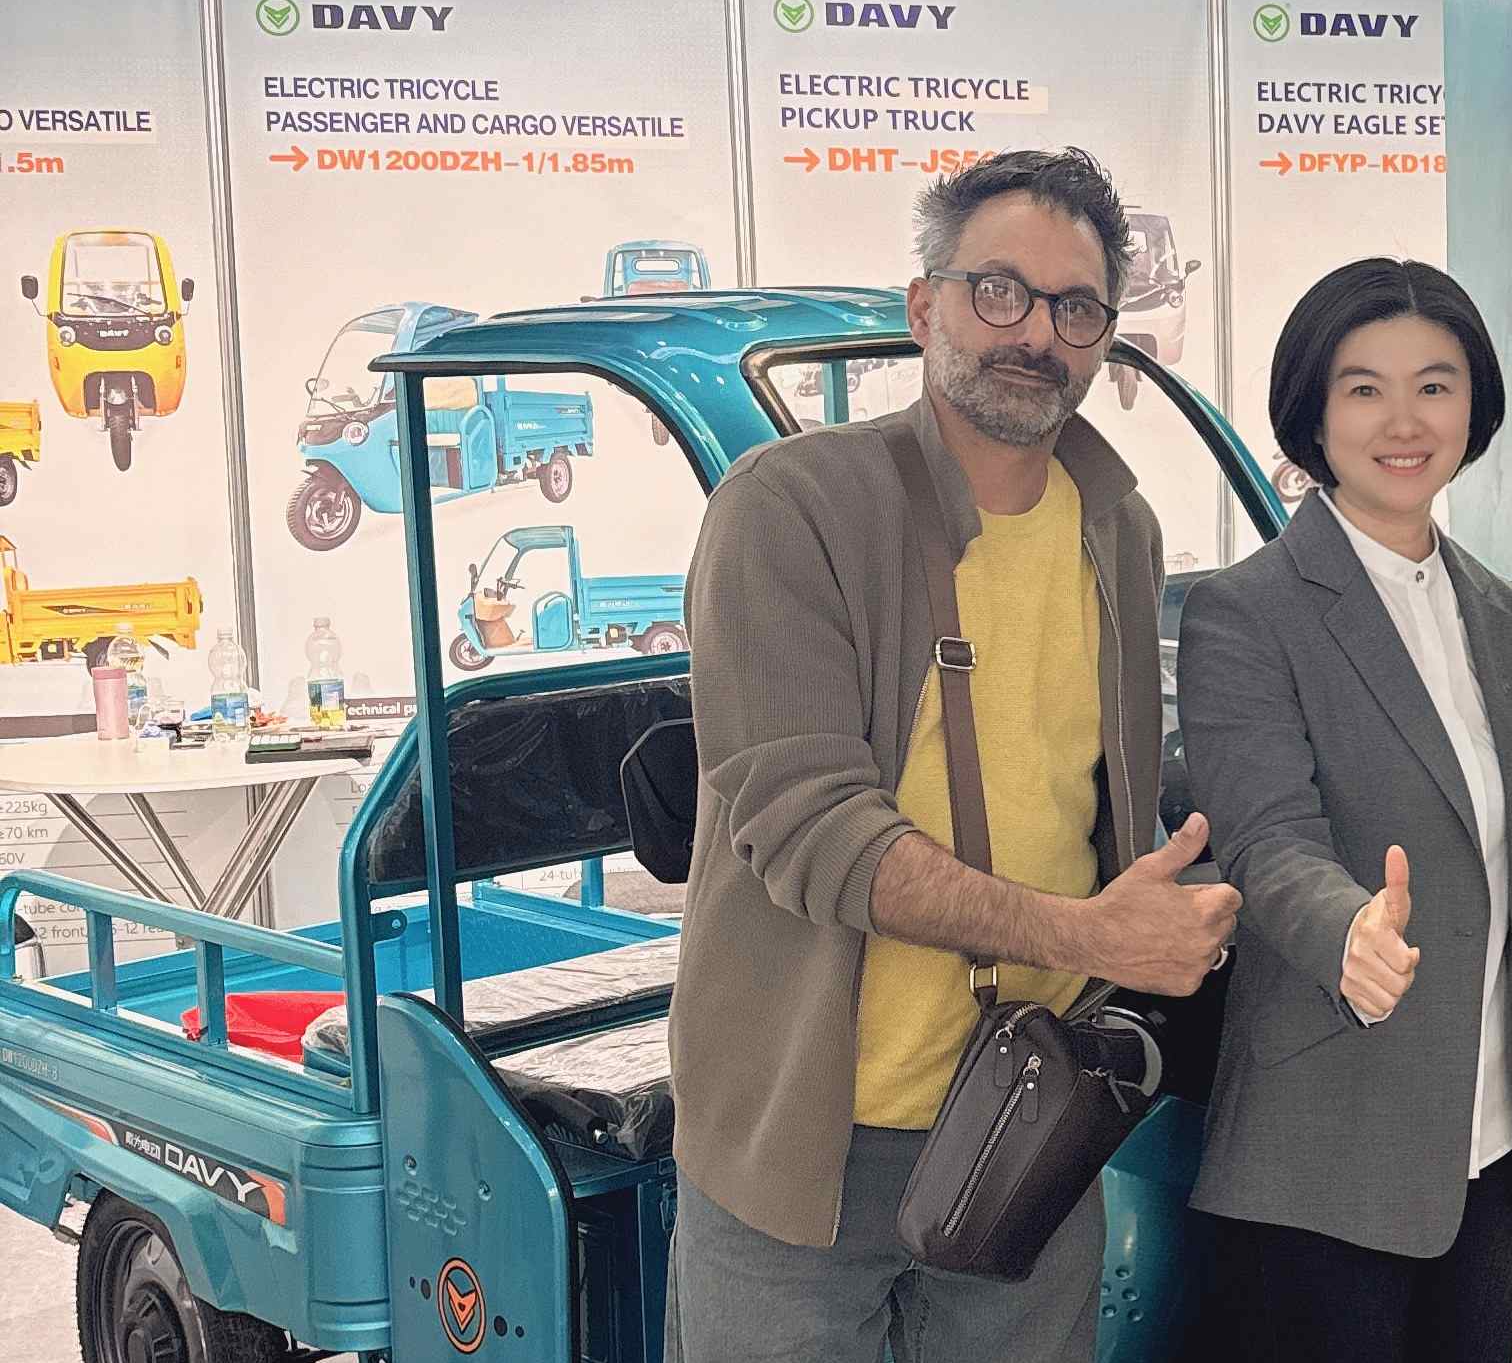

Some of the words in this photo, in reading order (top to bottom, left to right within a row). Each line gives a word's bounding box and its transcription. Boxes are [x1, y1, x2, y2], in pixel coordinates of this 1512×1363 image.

[312, 3, 454, 31] DAVY
[825, 1, 956, 30] DAVY
[1300, 13, 1418, 37] DAVY
[264, 76, 379, 99] ELECTRIC
[385, 78, 499, 101] TRICYCLE
[779, 73, 900, 97] ELECTRIC
[909, 77, 1029, 101] TRICYCLE
[1257, 81, 1367, 103] ELECTRIC
[1374, 84, 1445, 104] TRICY
[19, 109, 152, 132] VERSATILE
[266, 111, 410, 134] PASSENGER
[416, 113, 466, 135] AND
[472, 114, 557, 137] CARGO
[562, 115, 684, 138] VERSATILE
[781, 107, 878, 130] PICKUP
[887, 109, 976, 132] TRUCK
[1258, 113, 1325, 135] DAVY
[1333, 114, 1407, 135] EAGLE
[1414, 115, 1445, 136] SE
[28, 827, 48, 838] km
[165, 1142, 262, 1202] DAVY
